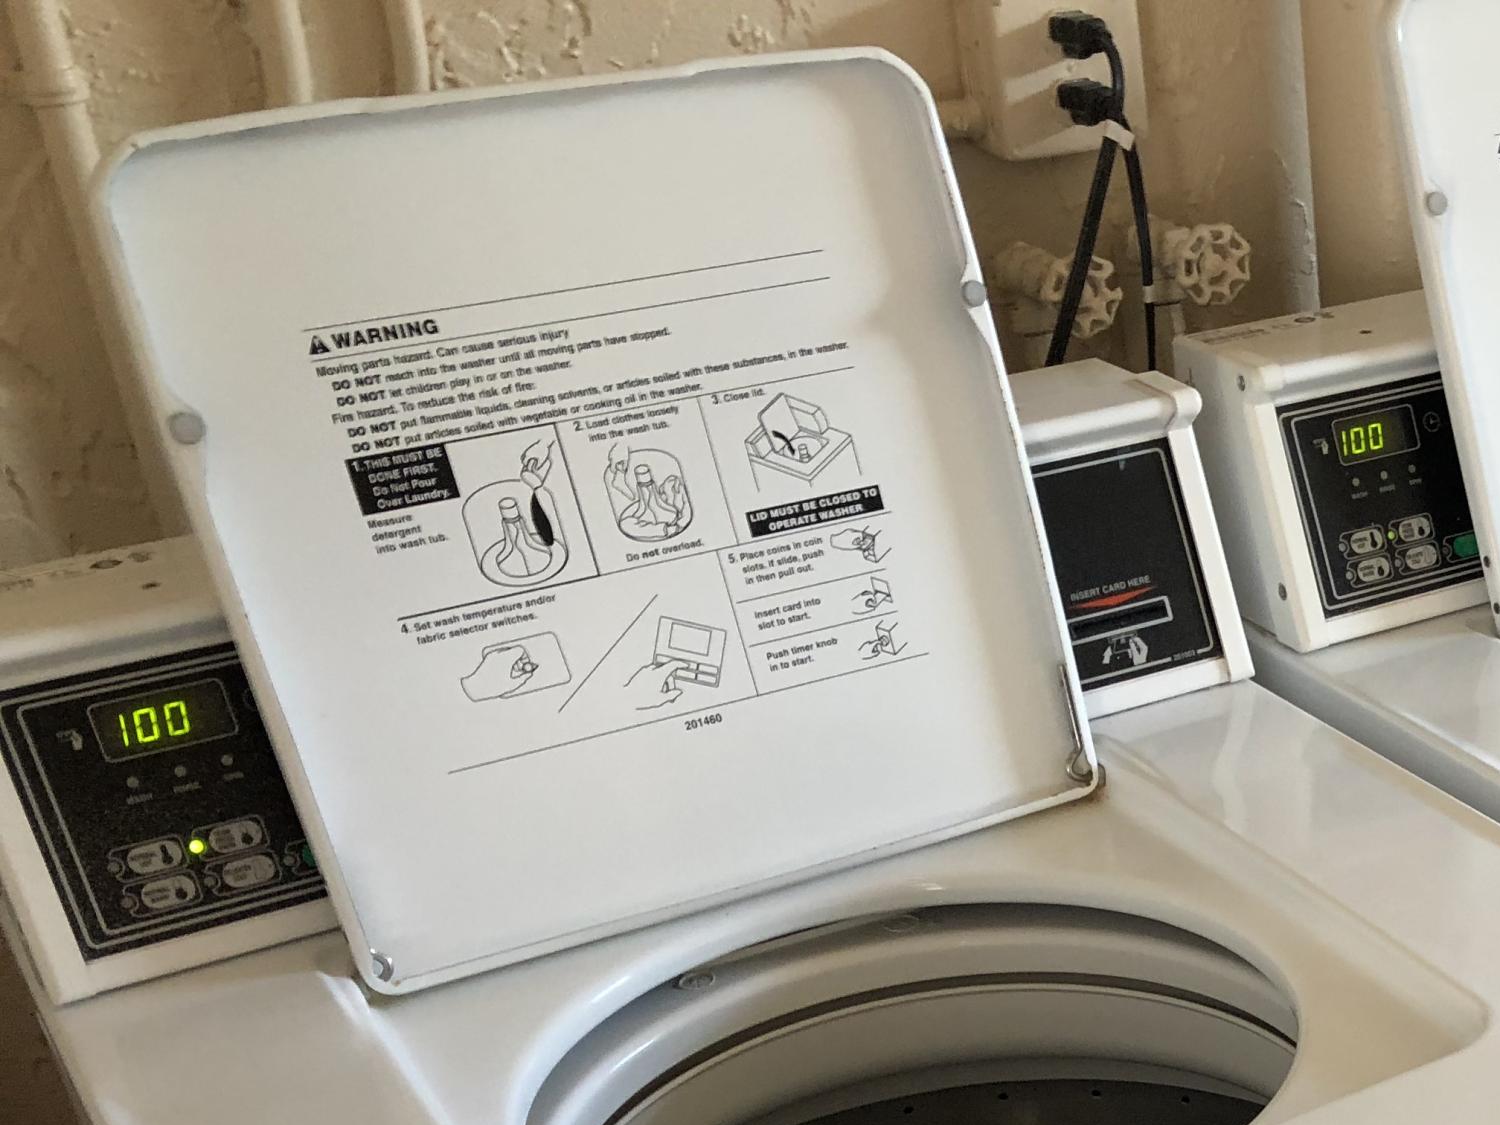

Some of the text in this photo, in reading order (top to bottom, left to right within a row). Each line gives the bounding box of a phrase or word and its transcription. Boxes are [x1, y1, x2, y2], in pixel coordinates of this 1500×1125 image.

[330, 319, 439, 348] WARNING
[331, 379, 351, 391] DO
[354, 374, 381, 387] NOT
[336, 394, 356, 407] DO
[358, 389, 385, 402] NOT
[347, 425, 366, 437] DO
[369, 420, 396, 433] NOT
[1342, 422, 1384, 456] 100
[351, 441, 371, 453] DO
[373, 435, 400, 449] NOT
[749, 487, 877, 522] LID MUST BE CLOSED TO
[768, 503, 863, 530] OPERATE WASHER
[1070, 575, 1152, 601] INSERT CARD HERE
[118, 700, 191, 747] 100
[684, 712, 722, 730] 201460
